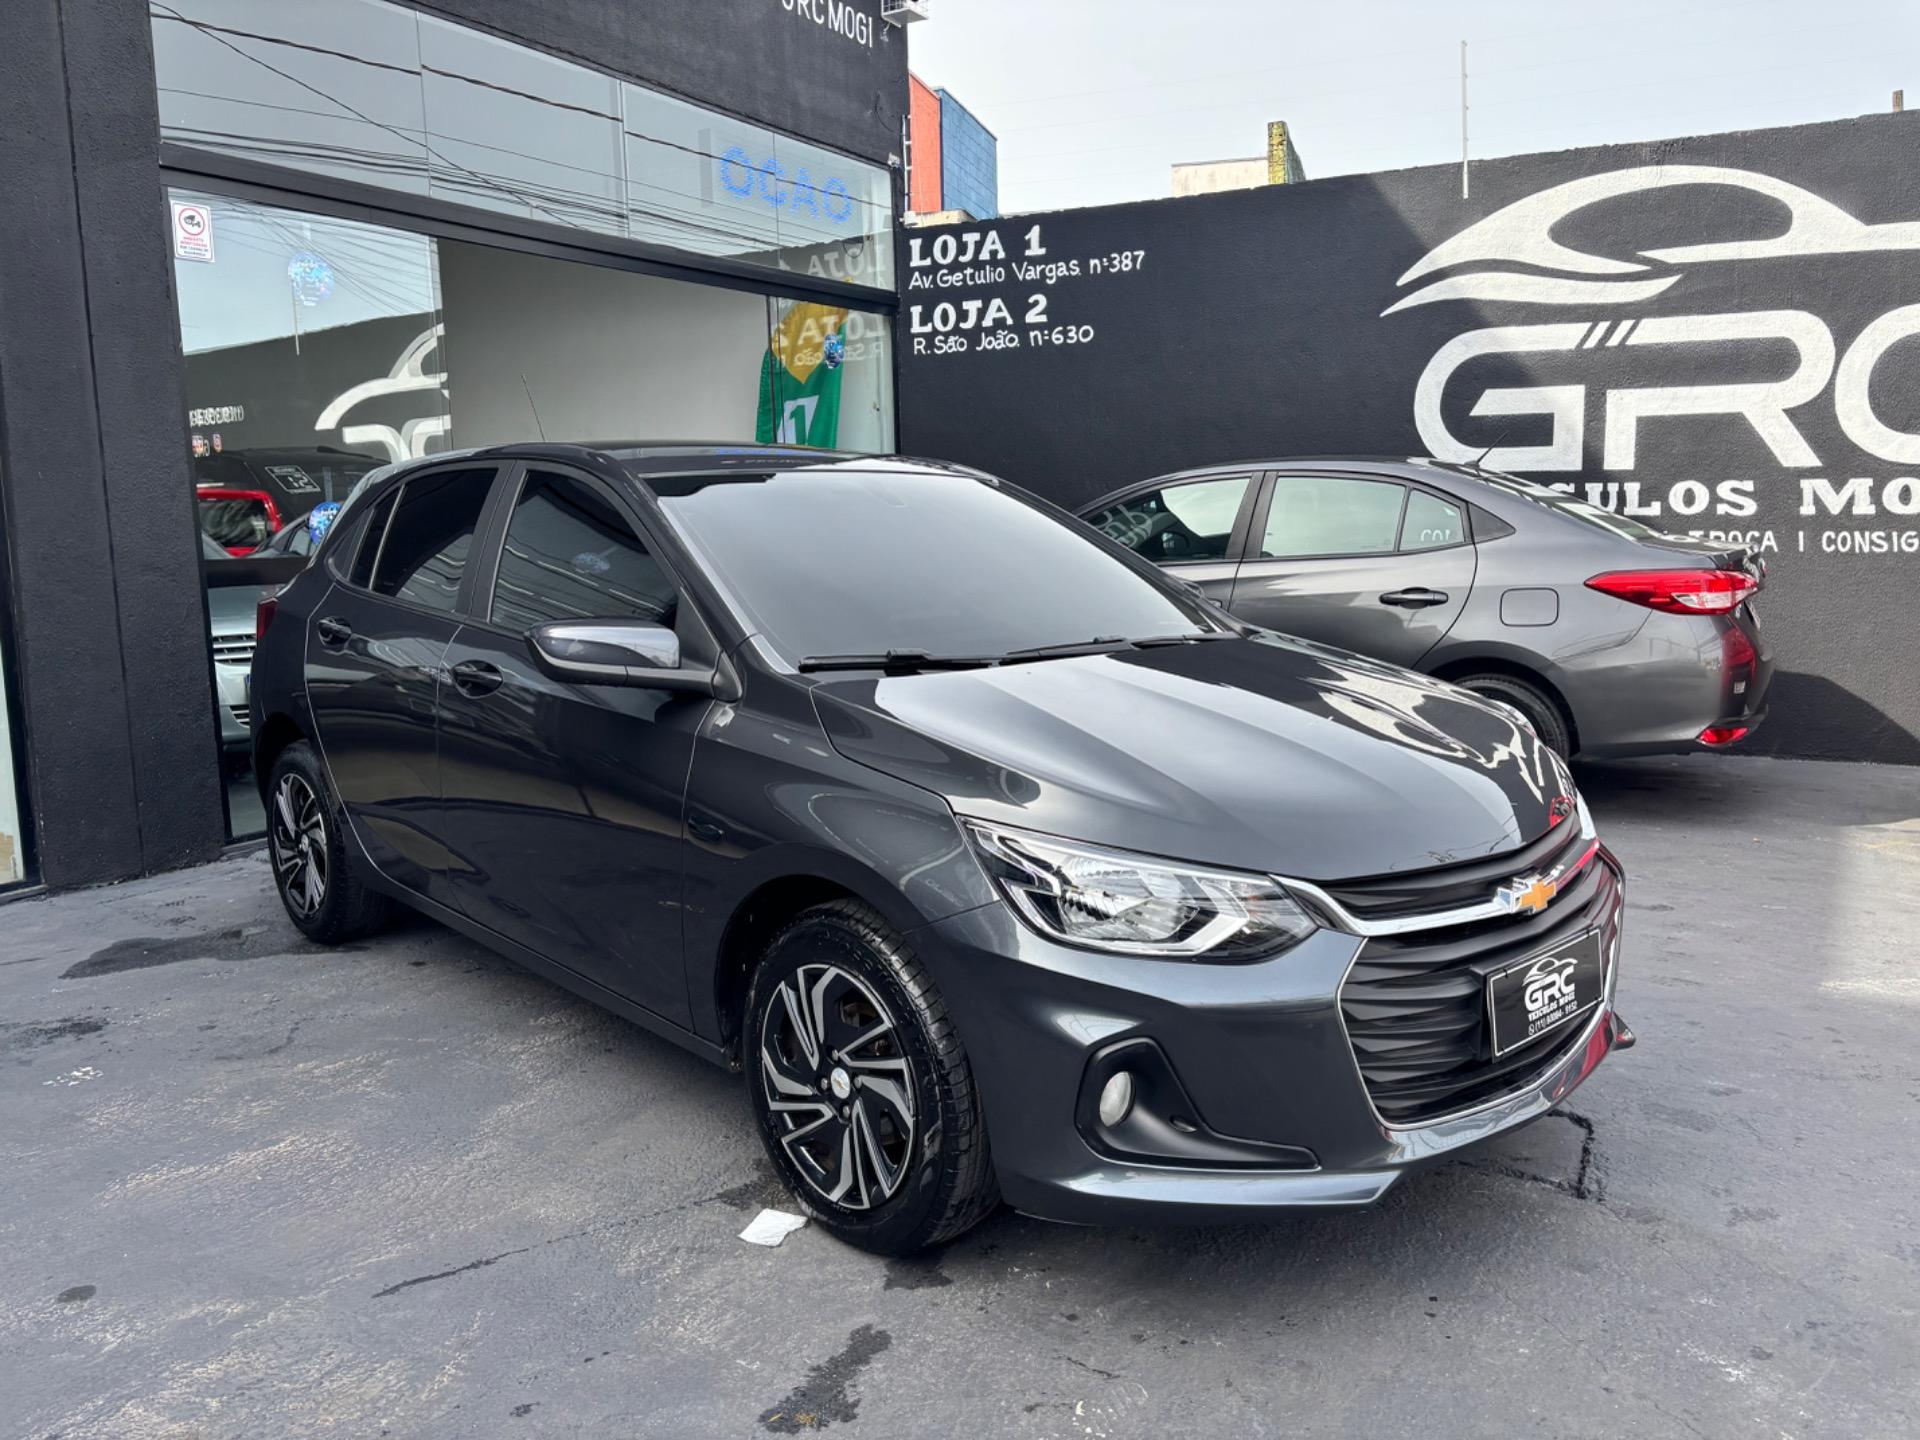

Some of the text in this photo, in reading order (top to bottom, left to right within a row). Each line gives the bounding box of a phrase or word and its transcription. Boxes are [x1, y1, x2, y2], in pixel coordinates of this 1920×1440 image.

[828, 0, 872, 48] MOGI
[909, 225, 1047, 268] LOJA 1
[908, 271, 934, 290] Av.
[936, 264, 1005, 288] Getulio
[909, 294, 1048, 333] LOJA 2
[913, 337, 931, 355] R.
[933, 335, 967, 355] São
[1524, 965, 1575, 1012] GRC
